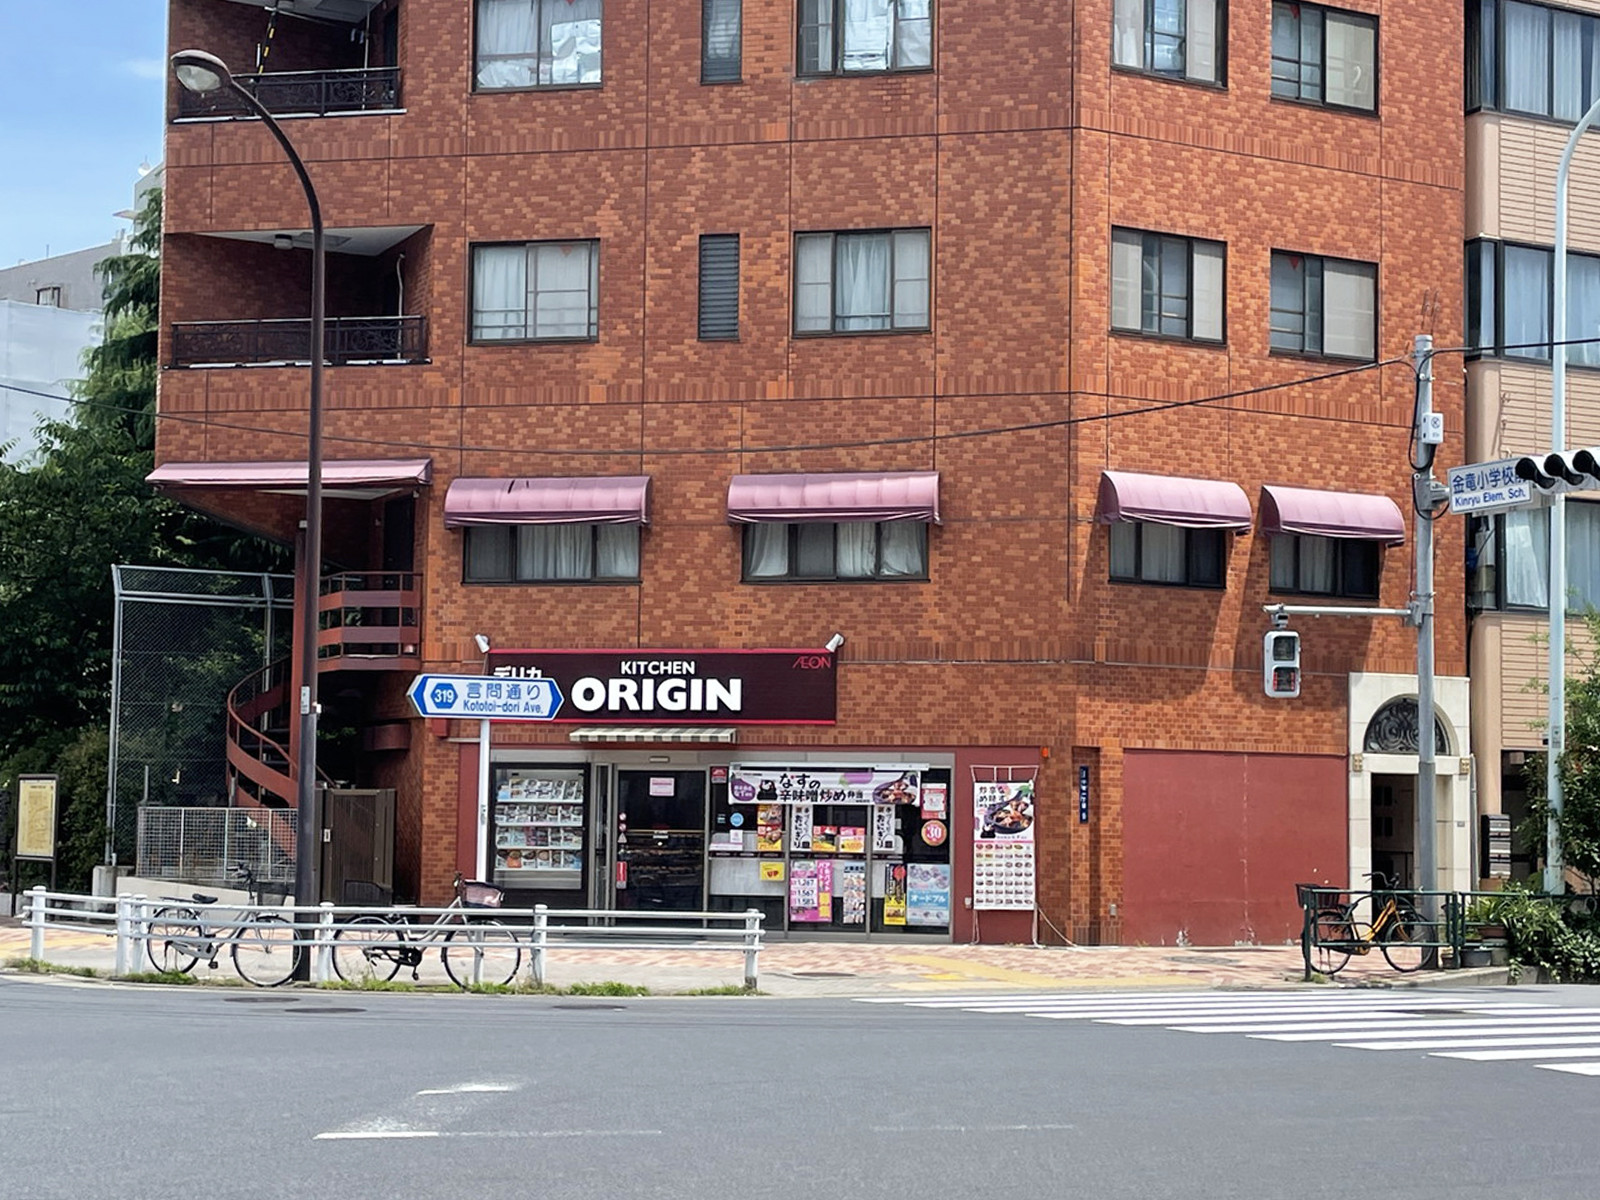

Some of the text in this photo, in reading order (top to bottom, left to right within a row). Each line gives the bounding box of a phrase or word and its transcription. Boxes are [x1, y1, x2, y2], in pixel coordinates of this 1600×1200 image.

[1455, 486, 1526, 506] Kinryu Elem. Sch.
[621, 661, 696, 675] KITCHEN
[434, 689, 454, 704] 319
[466, 682, 541, 700] 言問通り
[571, 677, 742, 712] ORIGIN
[463, 699, 543, 714] Kototoi-dori Ave.
[779, 773, 821, 789] なすの
[911, 894, 946, 903] オードブル
